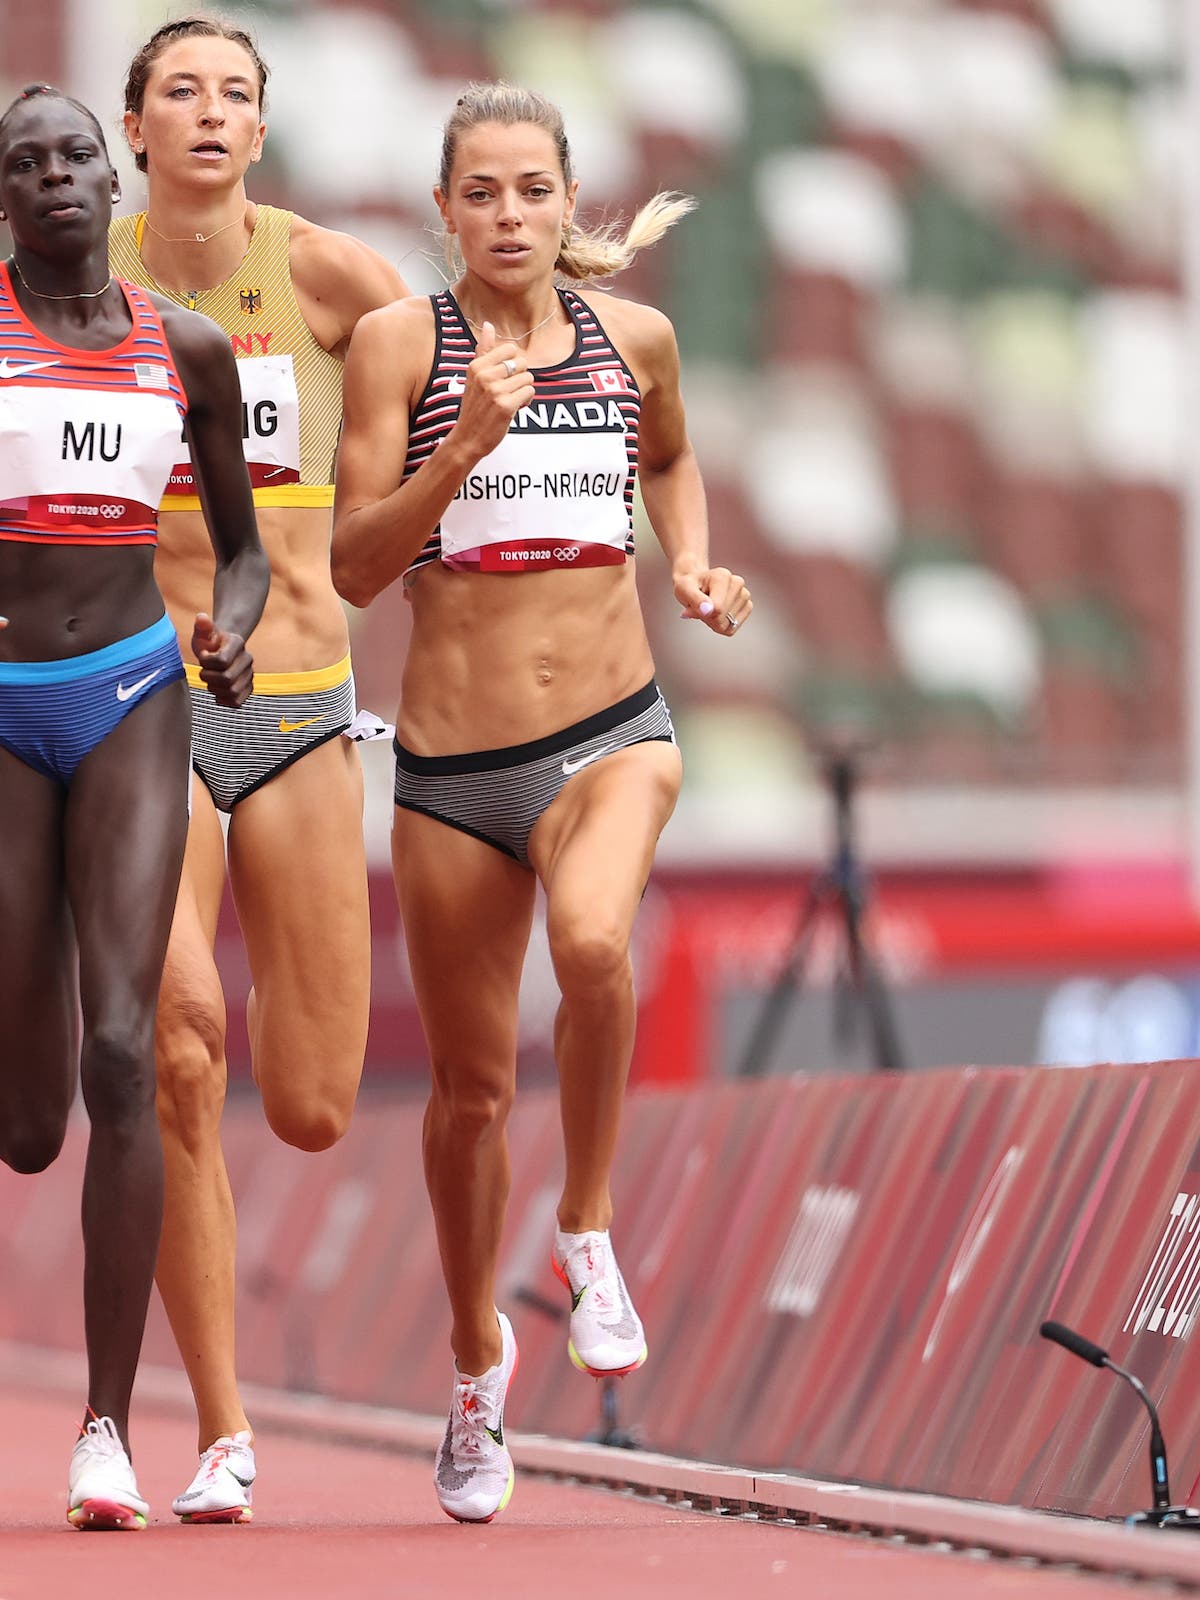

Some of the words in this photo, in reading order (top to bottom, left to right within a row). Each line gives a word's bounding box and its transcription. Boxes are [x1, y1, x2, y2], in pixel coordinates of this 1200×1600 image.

[509, 400, 628, 429] NADA
[62, 421, 122, 462] MU
[452, 472, 620, 501] ISHOP-NRIAGU
[48, 504, 76, 514] TOKYO
[76, 505, 99, 515] 2020
[500, 551, 529, 561] TOKYO
[530, 550, 551, 560] 2020
